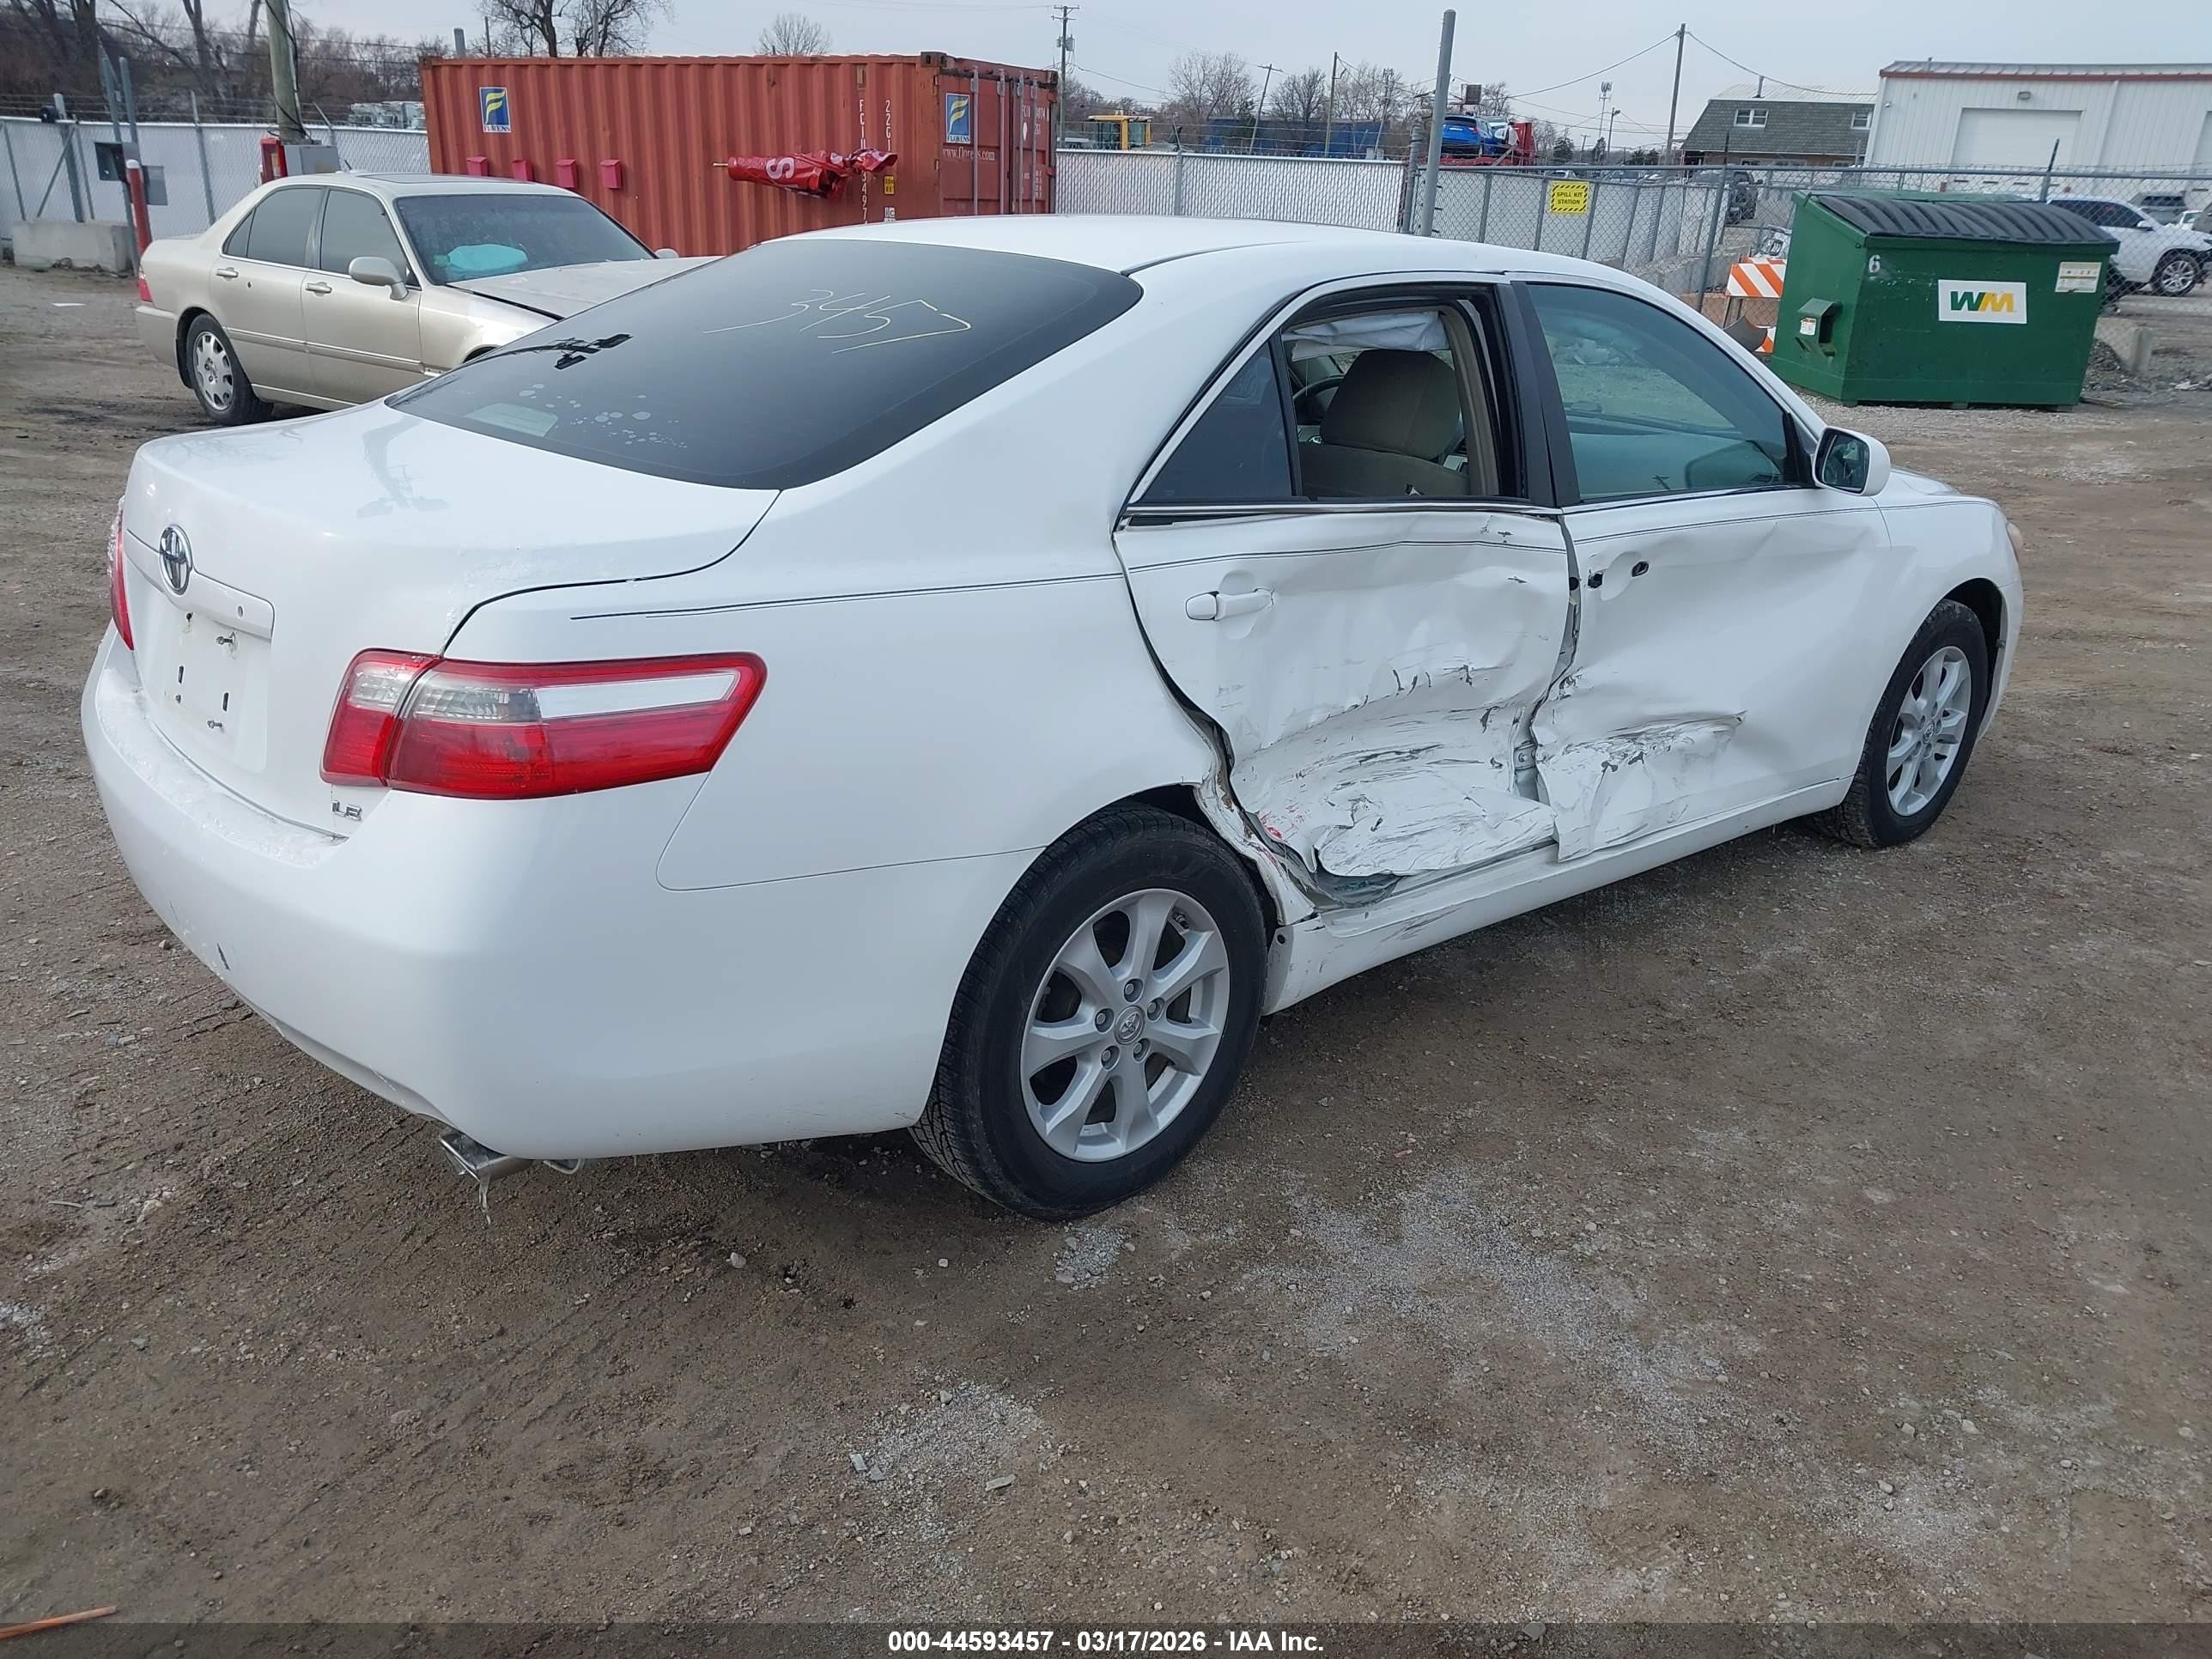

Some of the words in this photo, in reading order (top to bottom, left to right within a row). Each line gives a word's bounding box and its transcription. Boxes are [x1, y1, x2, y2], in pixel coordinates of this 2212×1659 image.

[943, 146, 995, 161] www.flores.com
[1869, 254, 1881, 273] 6
[1950, 290, 2014, 313] WM
